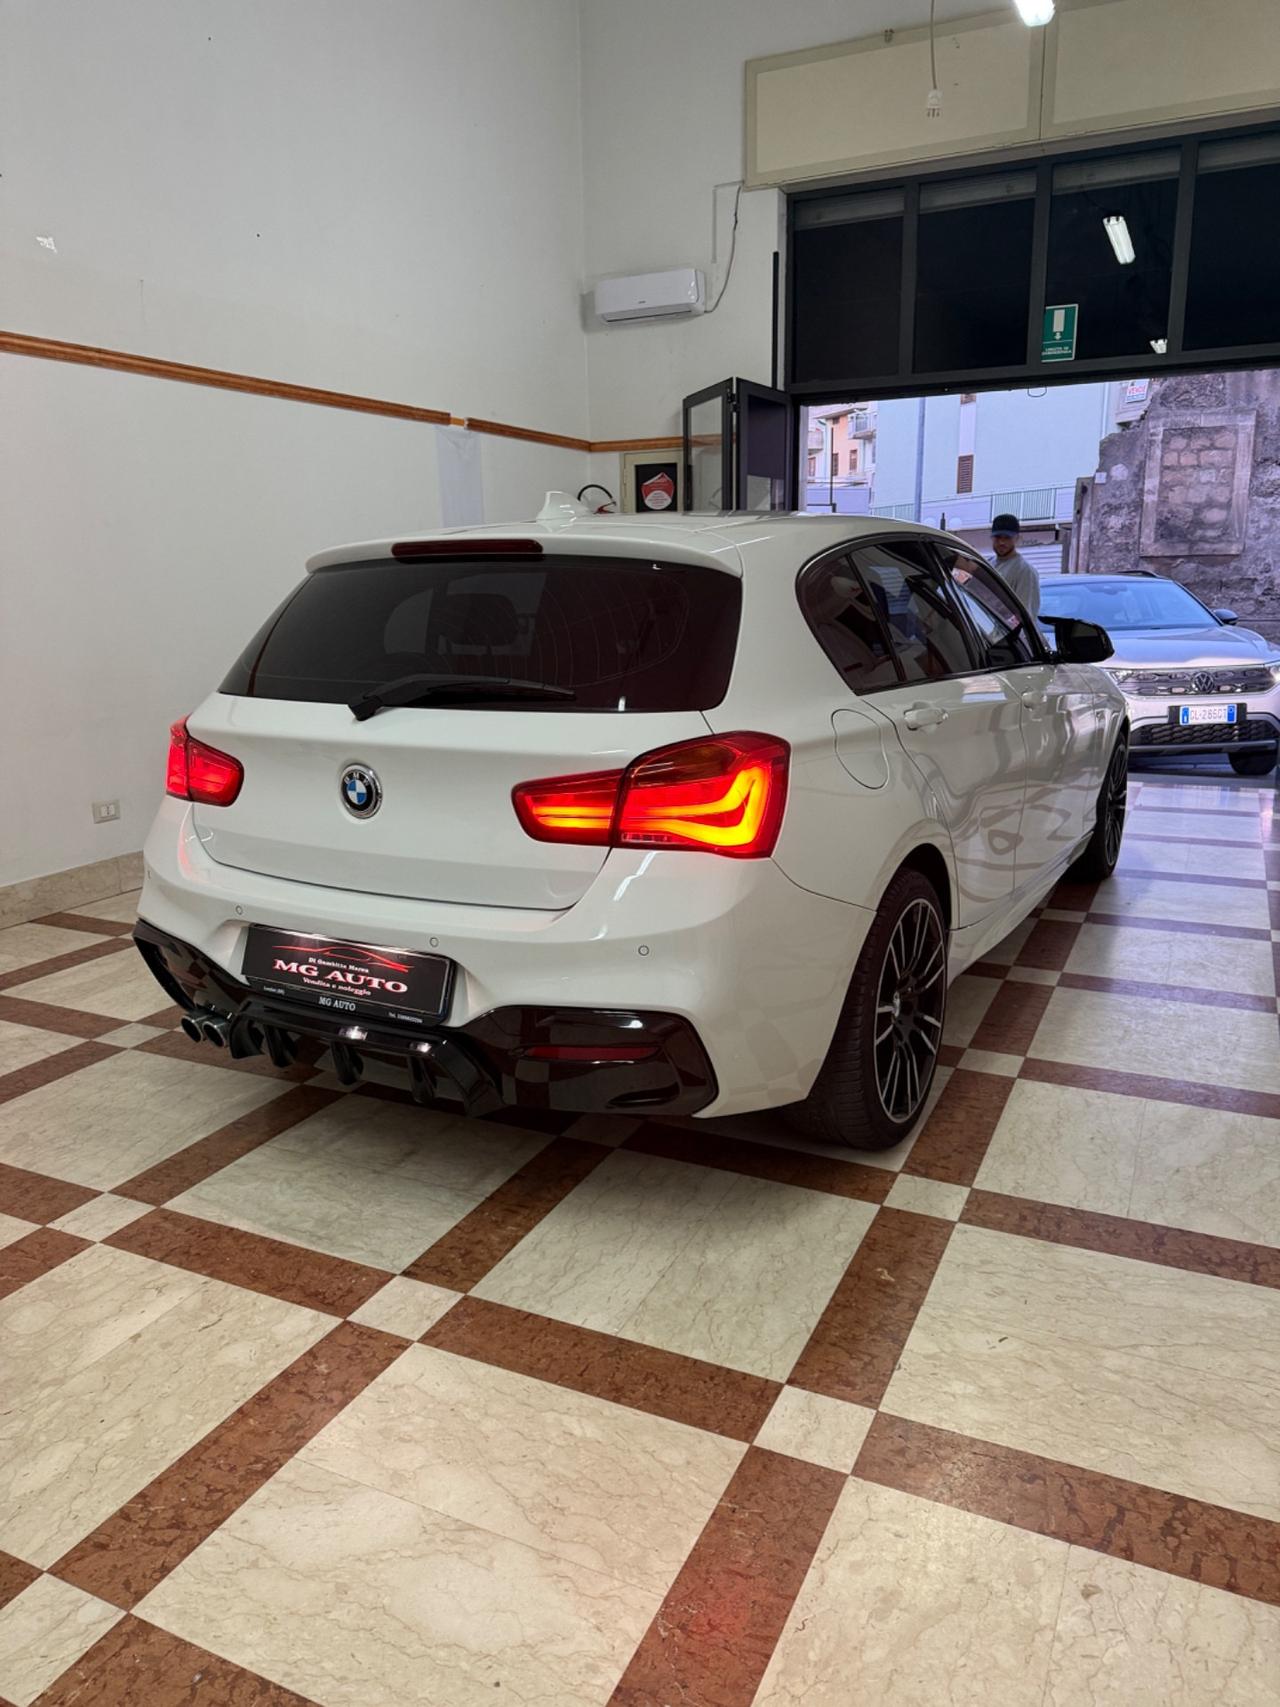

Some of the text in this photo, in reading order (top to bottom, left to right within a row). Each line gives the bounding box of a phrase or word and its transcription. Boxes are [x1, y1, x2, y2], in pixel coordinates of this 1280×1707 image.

[273, 959, 408, 993] MG AUTO
[318, 996, 356, 1011] MG AUTO
